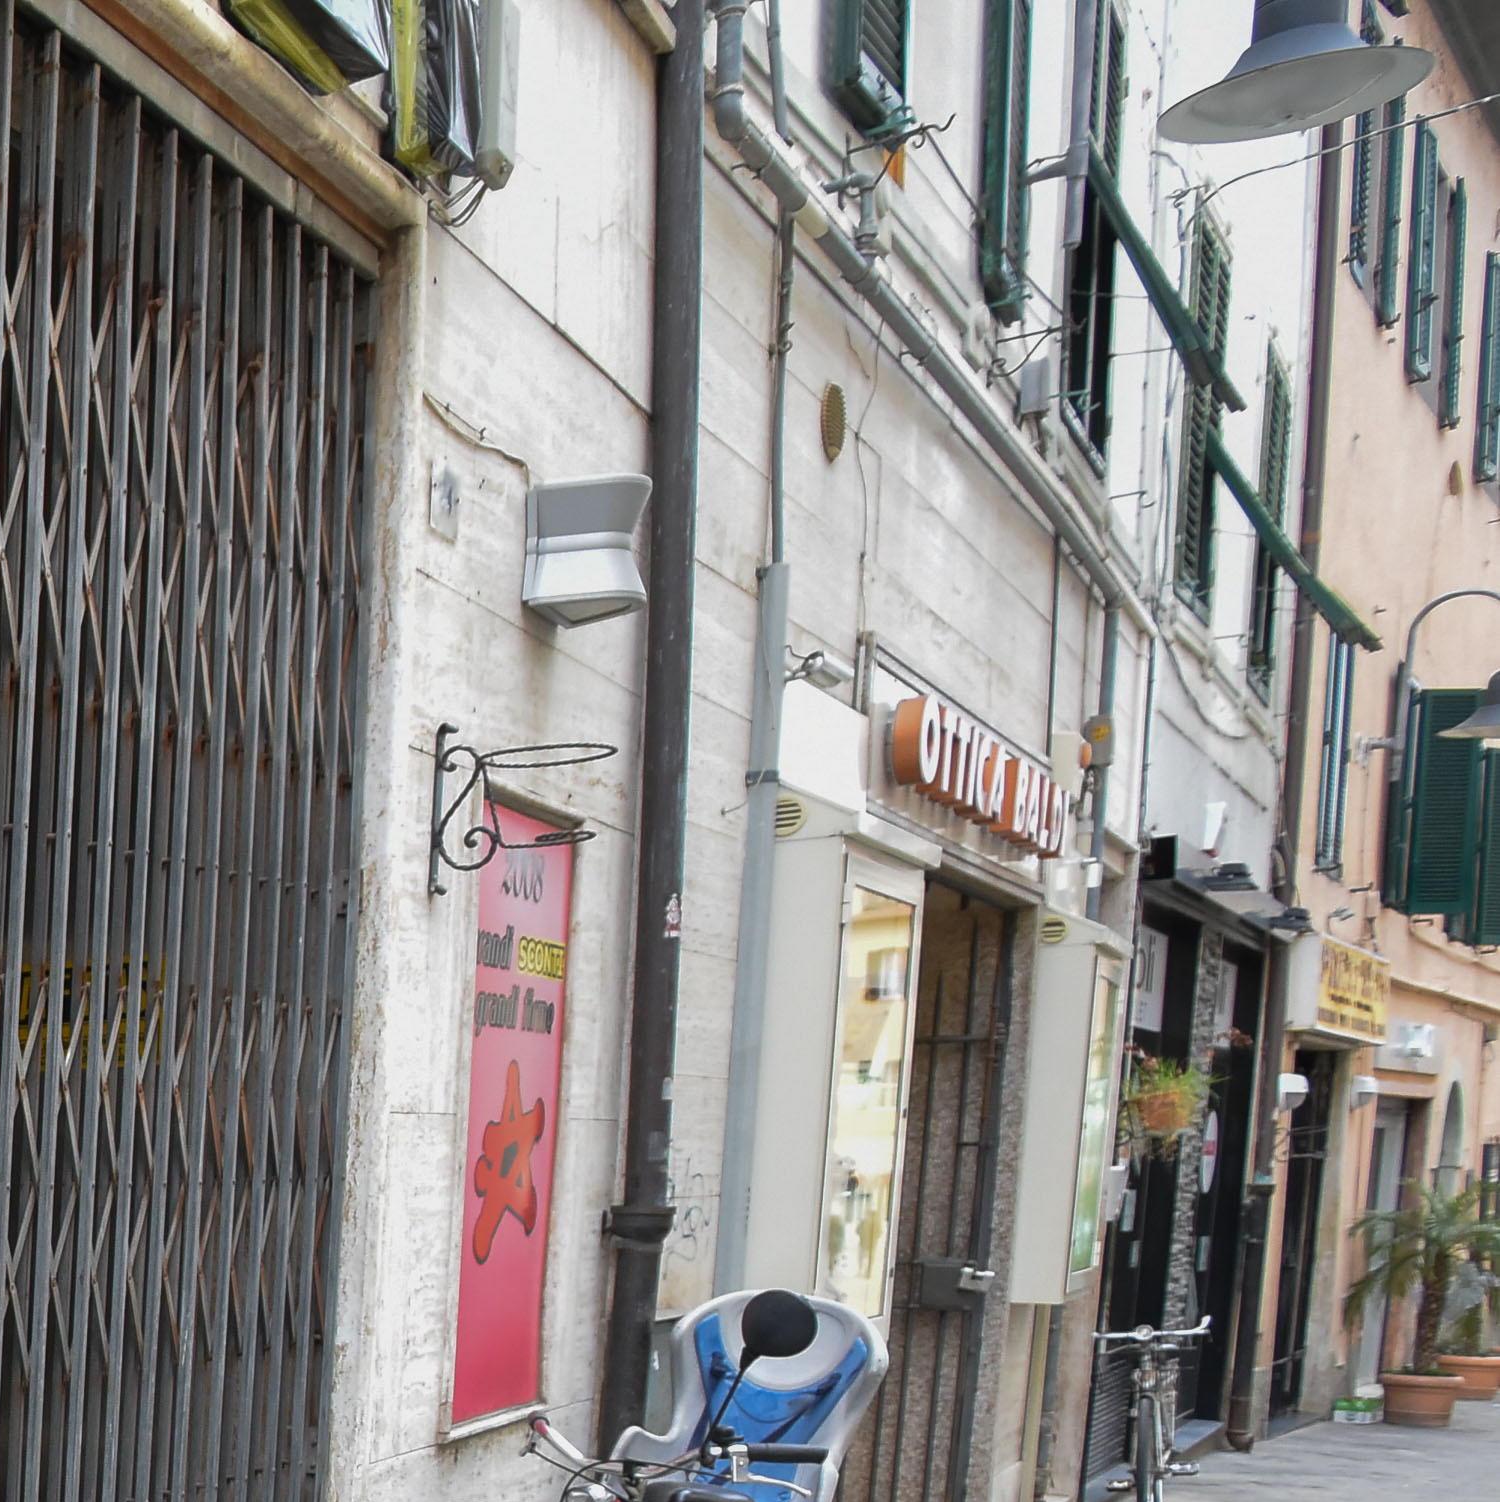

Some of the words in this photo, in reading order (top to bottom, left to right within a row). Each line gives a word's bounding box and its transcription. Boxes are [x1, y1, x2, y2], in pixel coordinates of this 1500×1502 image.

[916, 694, 1006, 824] OTTICA
[1011, 757, 1070, 858] BALDI
[501, 854, 545, 904] 2008
